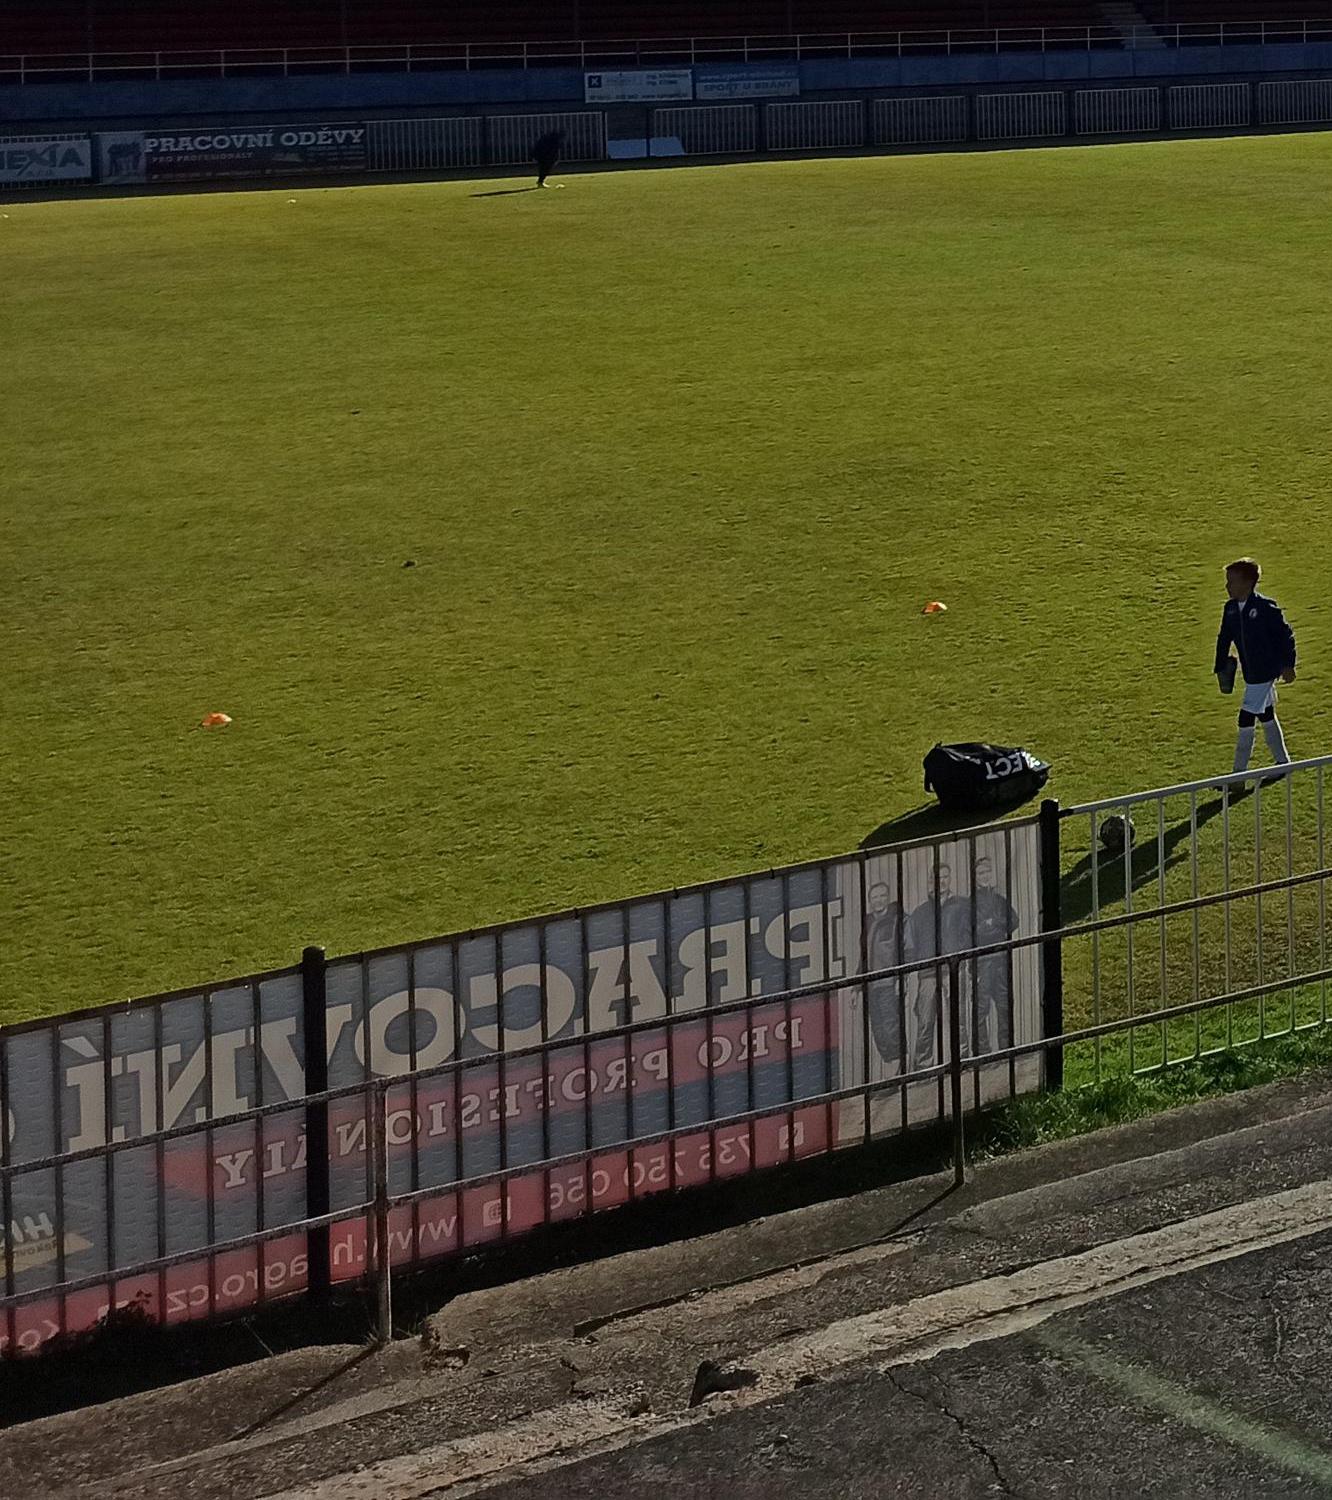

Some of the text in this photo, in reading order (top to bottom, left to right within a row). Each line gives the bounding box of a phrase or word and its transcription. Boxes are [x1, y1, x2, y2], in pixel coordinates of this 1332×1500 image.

[144, 126, 366, 153] PRACOVNÍ ODĚVY
[0, 144, 85, 173] EXIA
